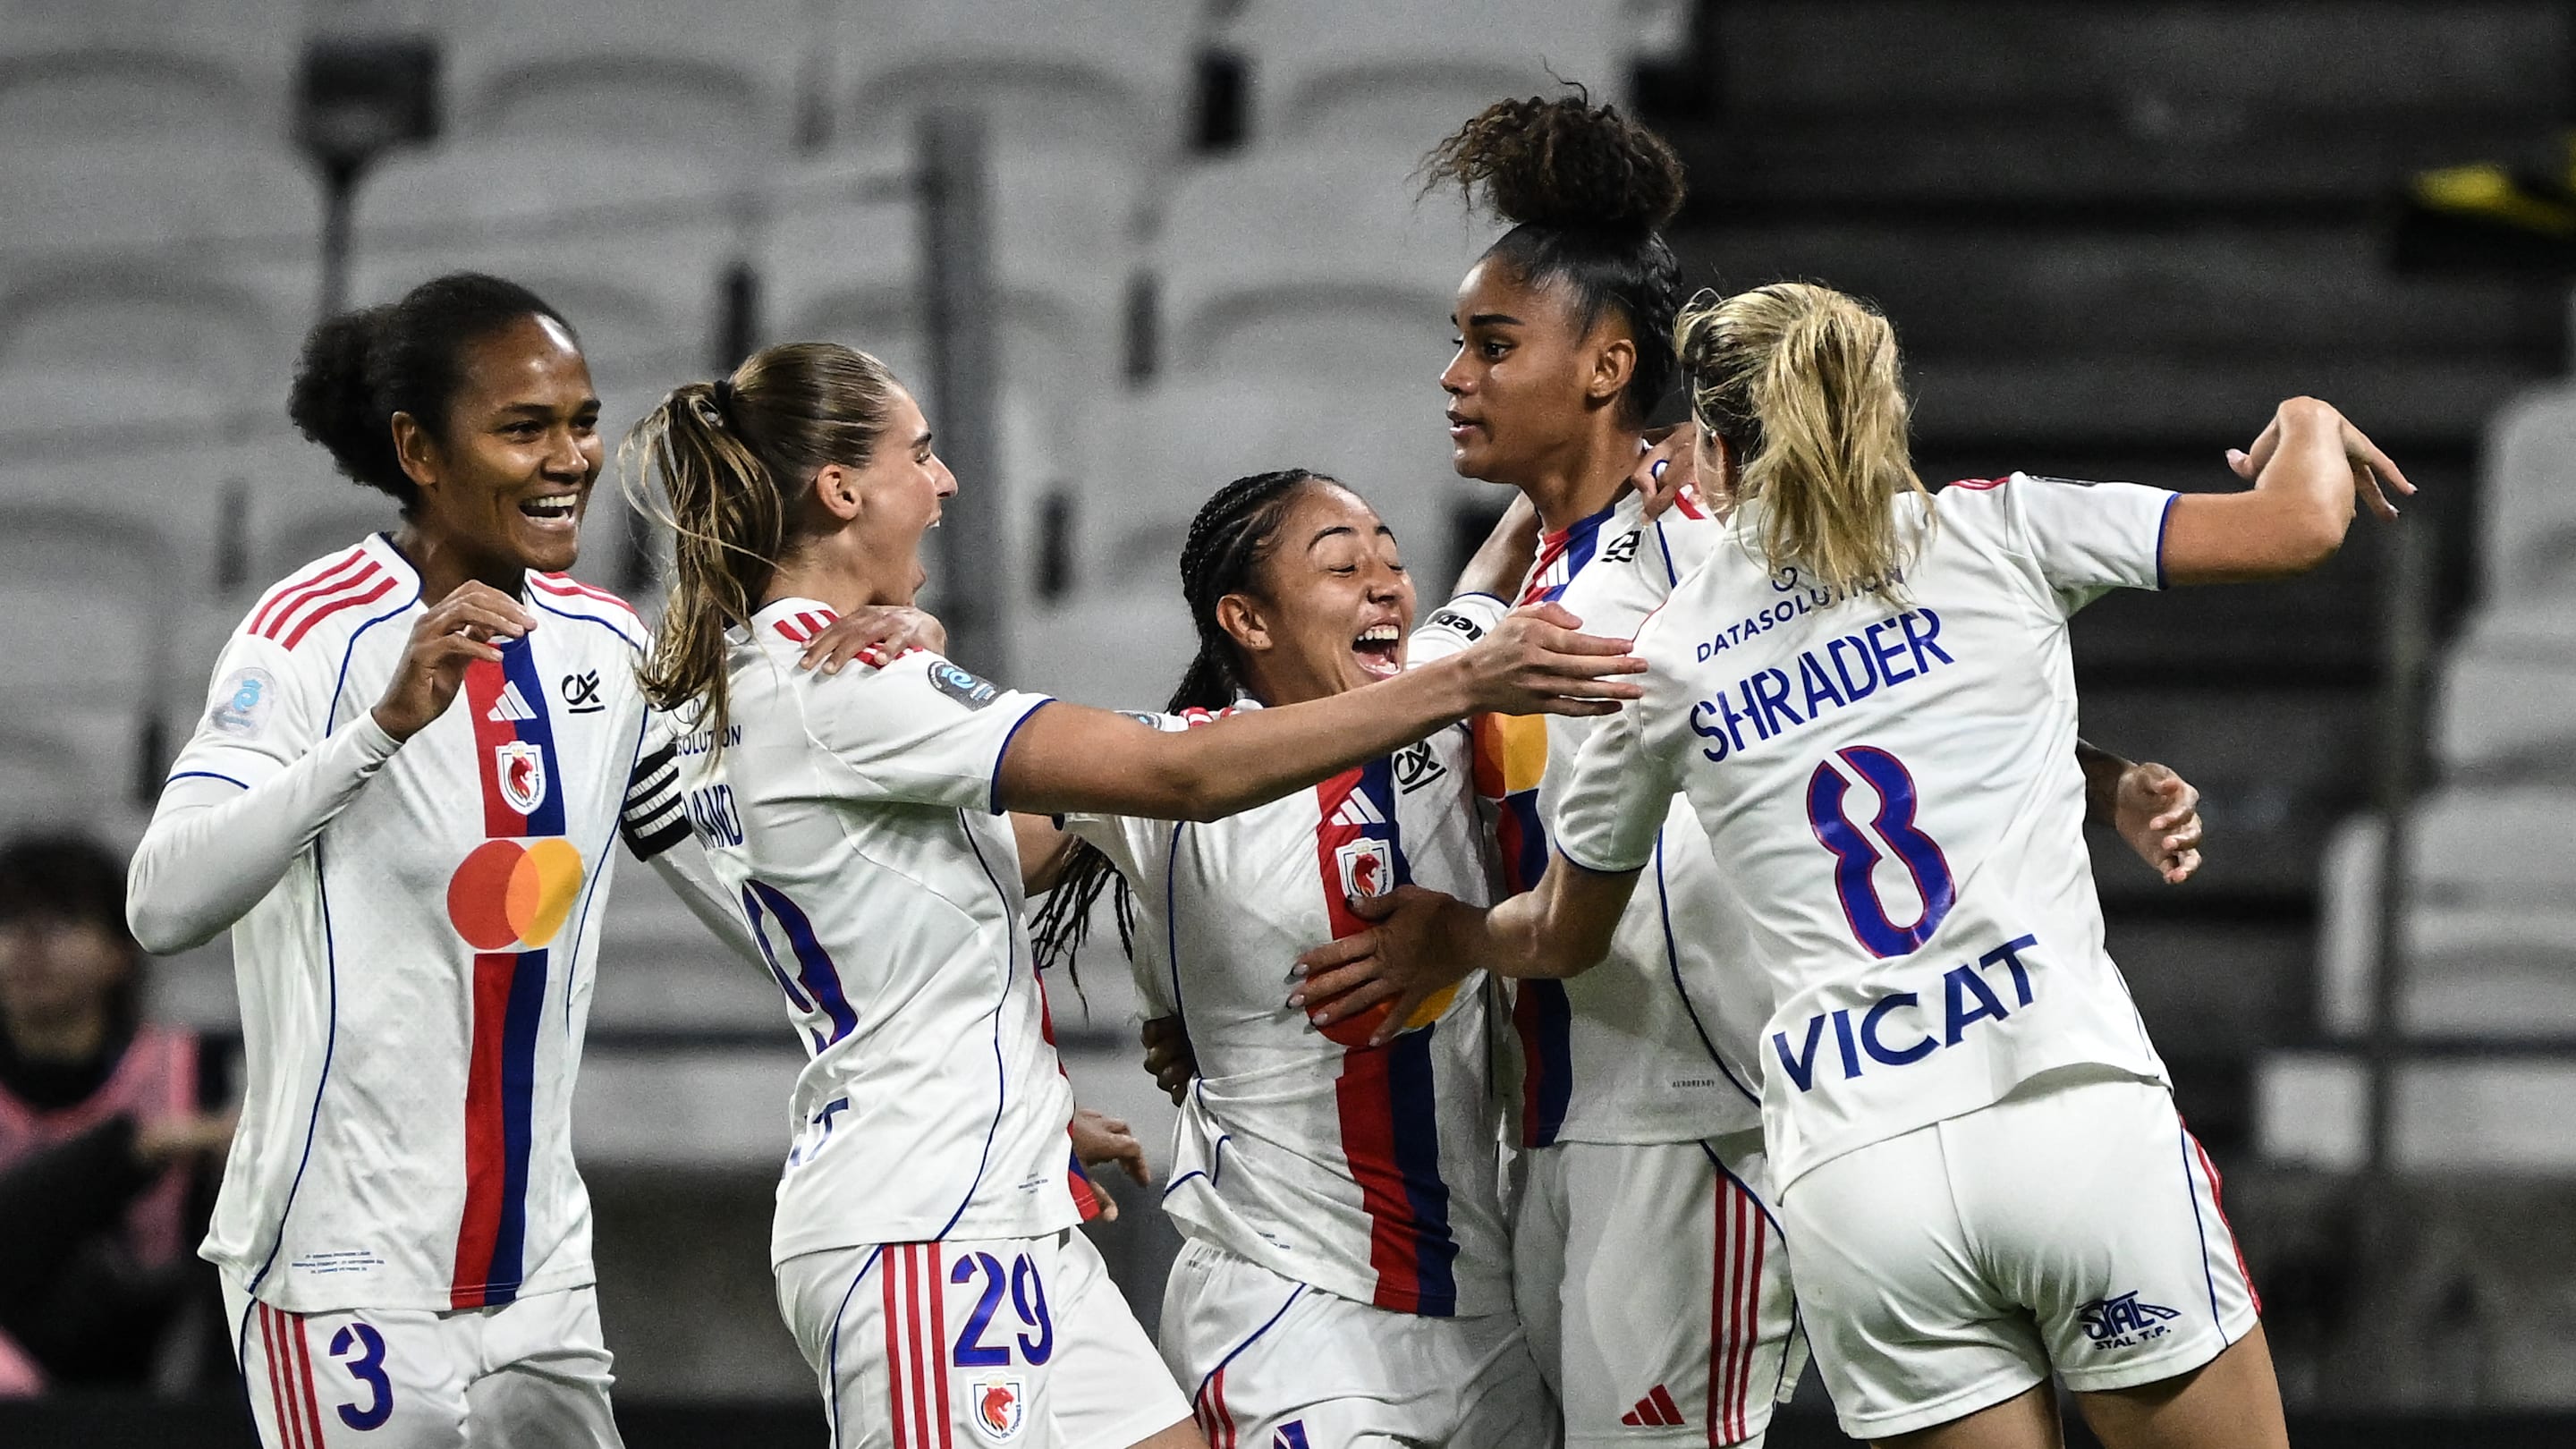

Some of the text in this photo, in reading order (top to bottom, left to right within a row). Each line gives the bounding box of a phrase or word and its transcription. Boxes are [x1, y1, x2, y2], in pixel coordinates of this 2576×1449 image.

[677, 724, 741, 756] OLUTON
[1690, 608, 1955, 762] SHRADER
[1807, 745, 1956, 959] 8
[1772, 934, 2038, 1092] VICAT
[951, 1251, 1054, 1367] 29
[2094, 1326, 2172, 1350] STAL T.P.
[329, 1323, 394, 1431] 3
